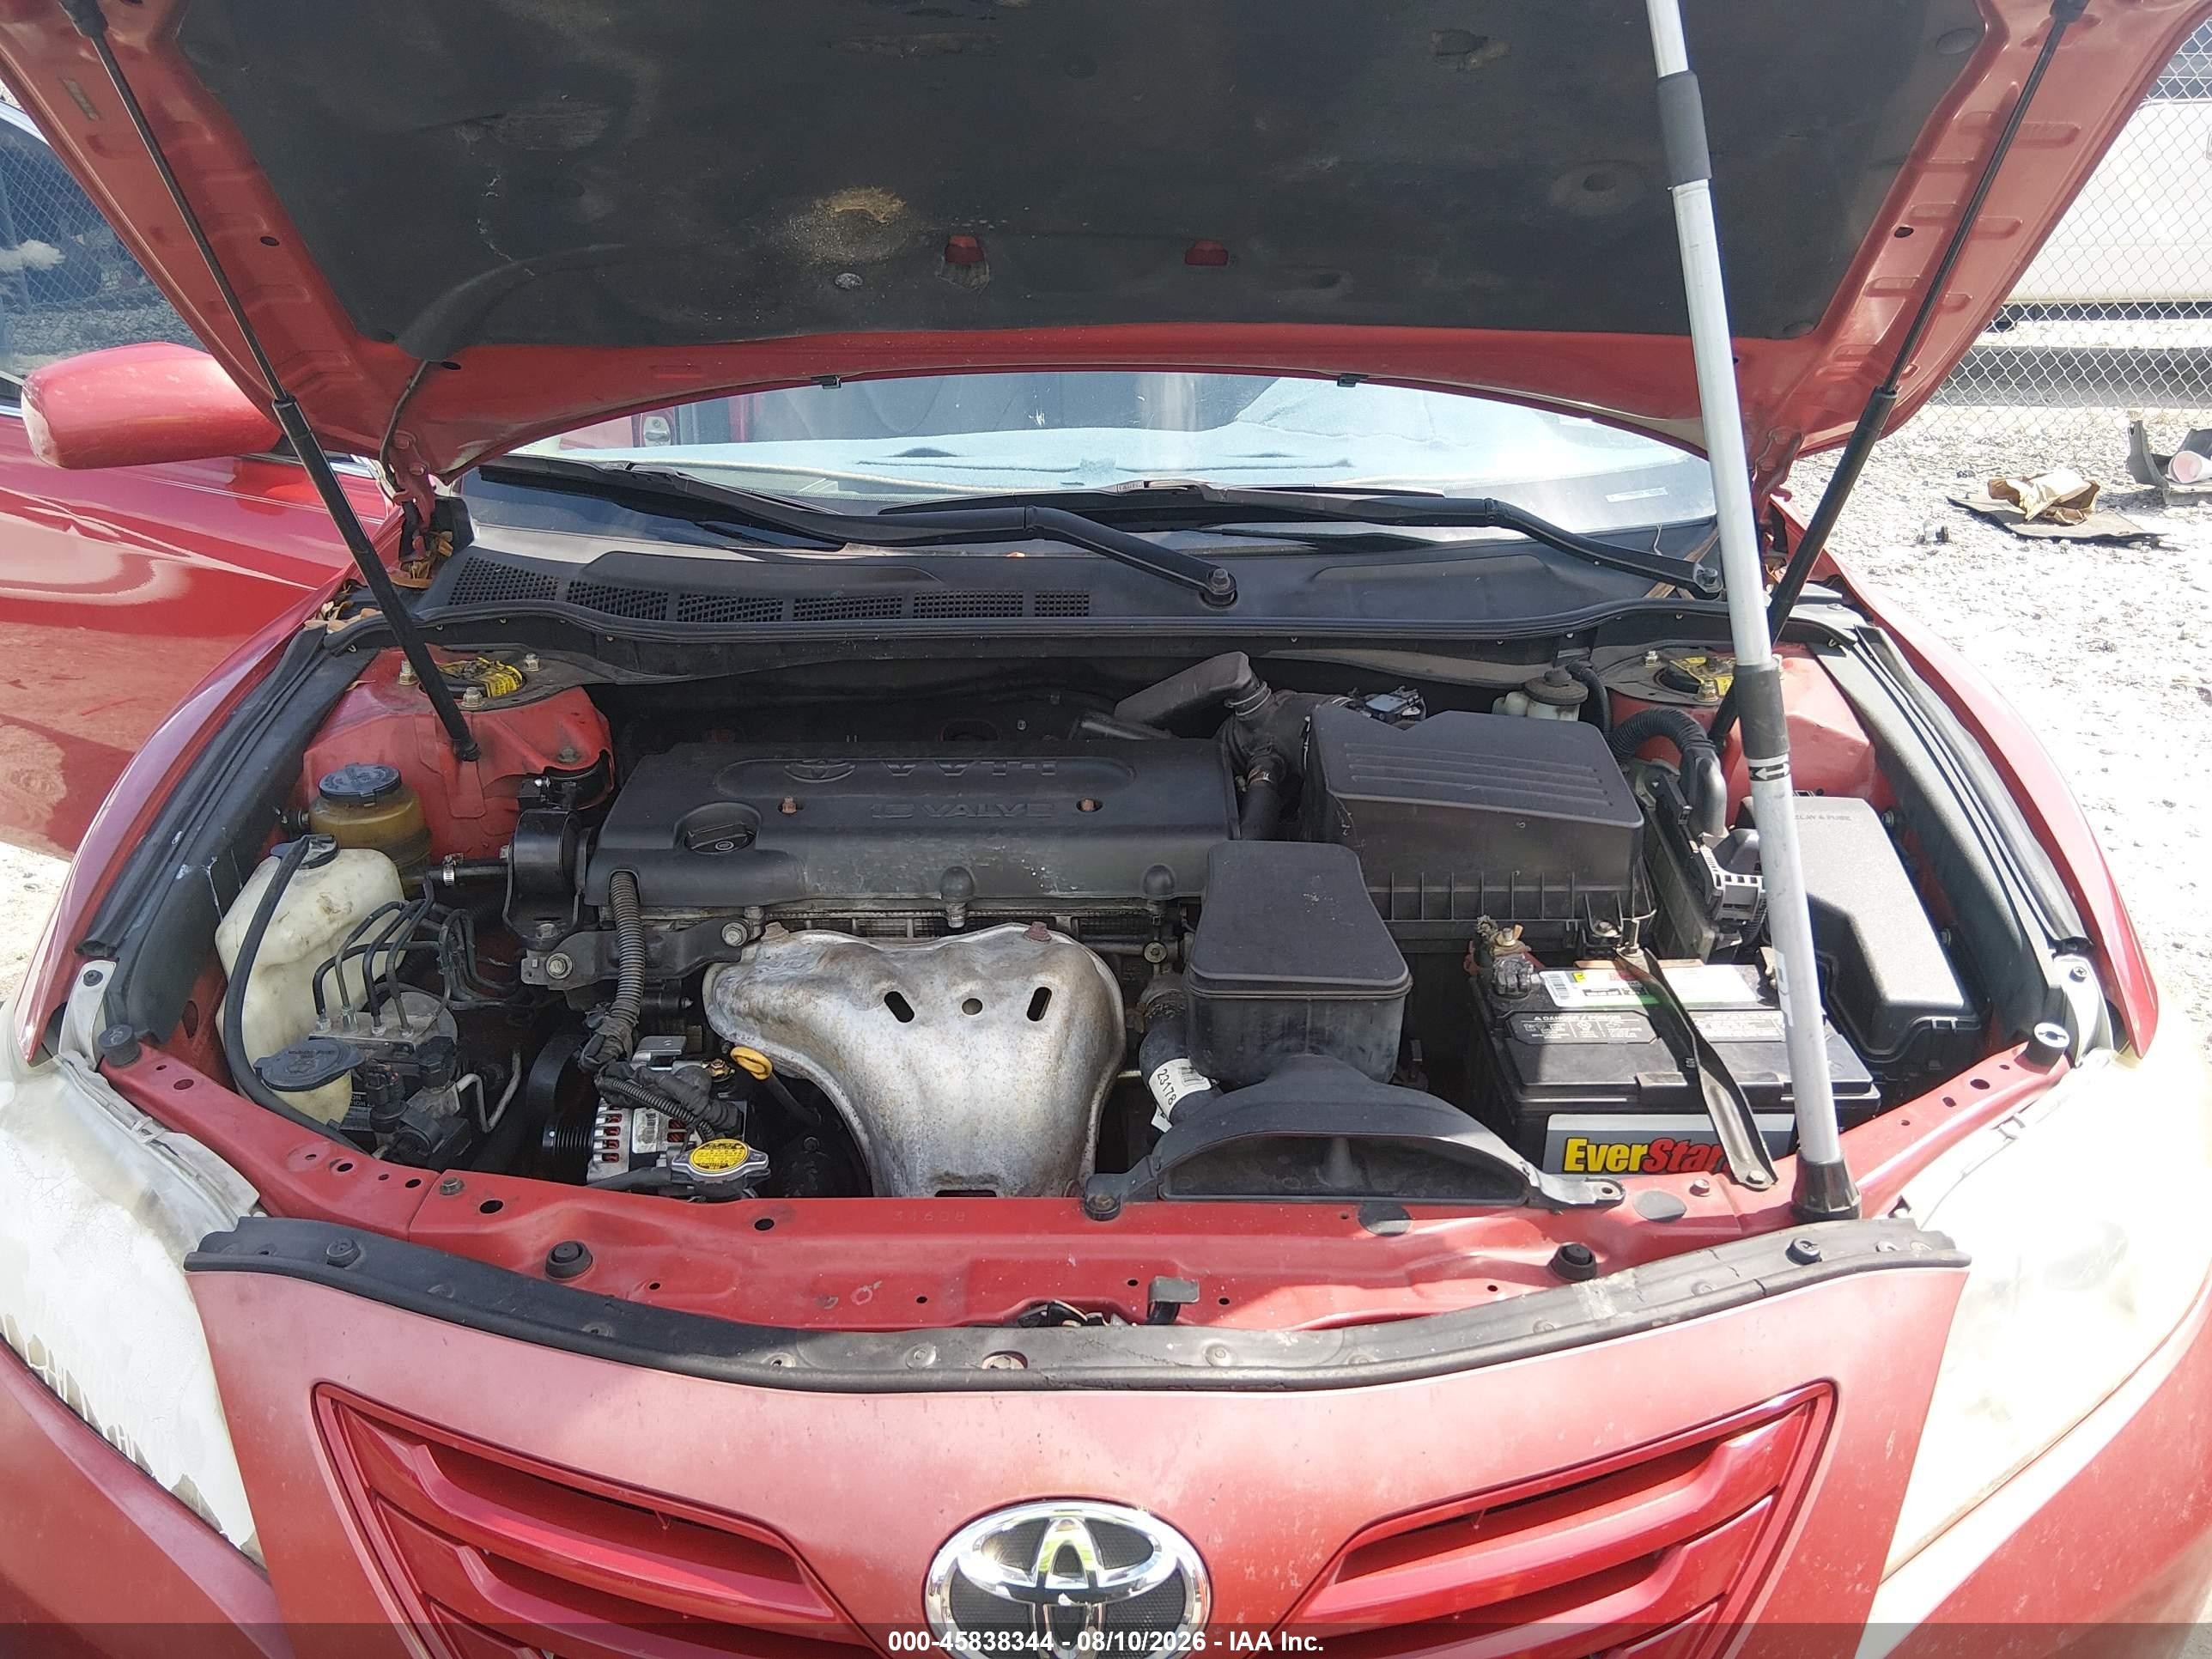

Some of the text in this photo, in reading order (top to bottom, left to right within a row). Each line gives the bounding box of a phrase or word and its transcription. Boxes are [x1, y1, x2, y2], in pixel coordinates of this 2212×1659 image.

[921, 803, 1055, 818] VALVE
[1157, 1068, 1177, 1106] 23178
[1562, 1137, 1730, 1174] EverStar
